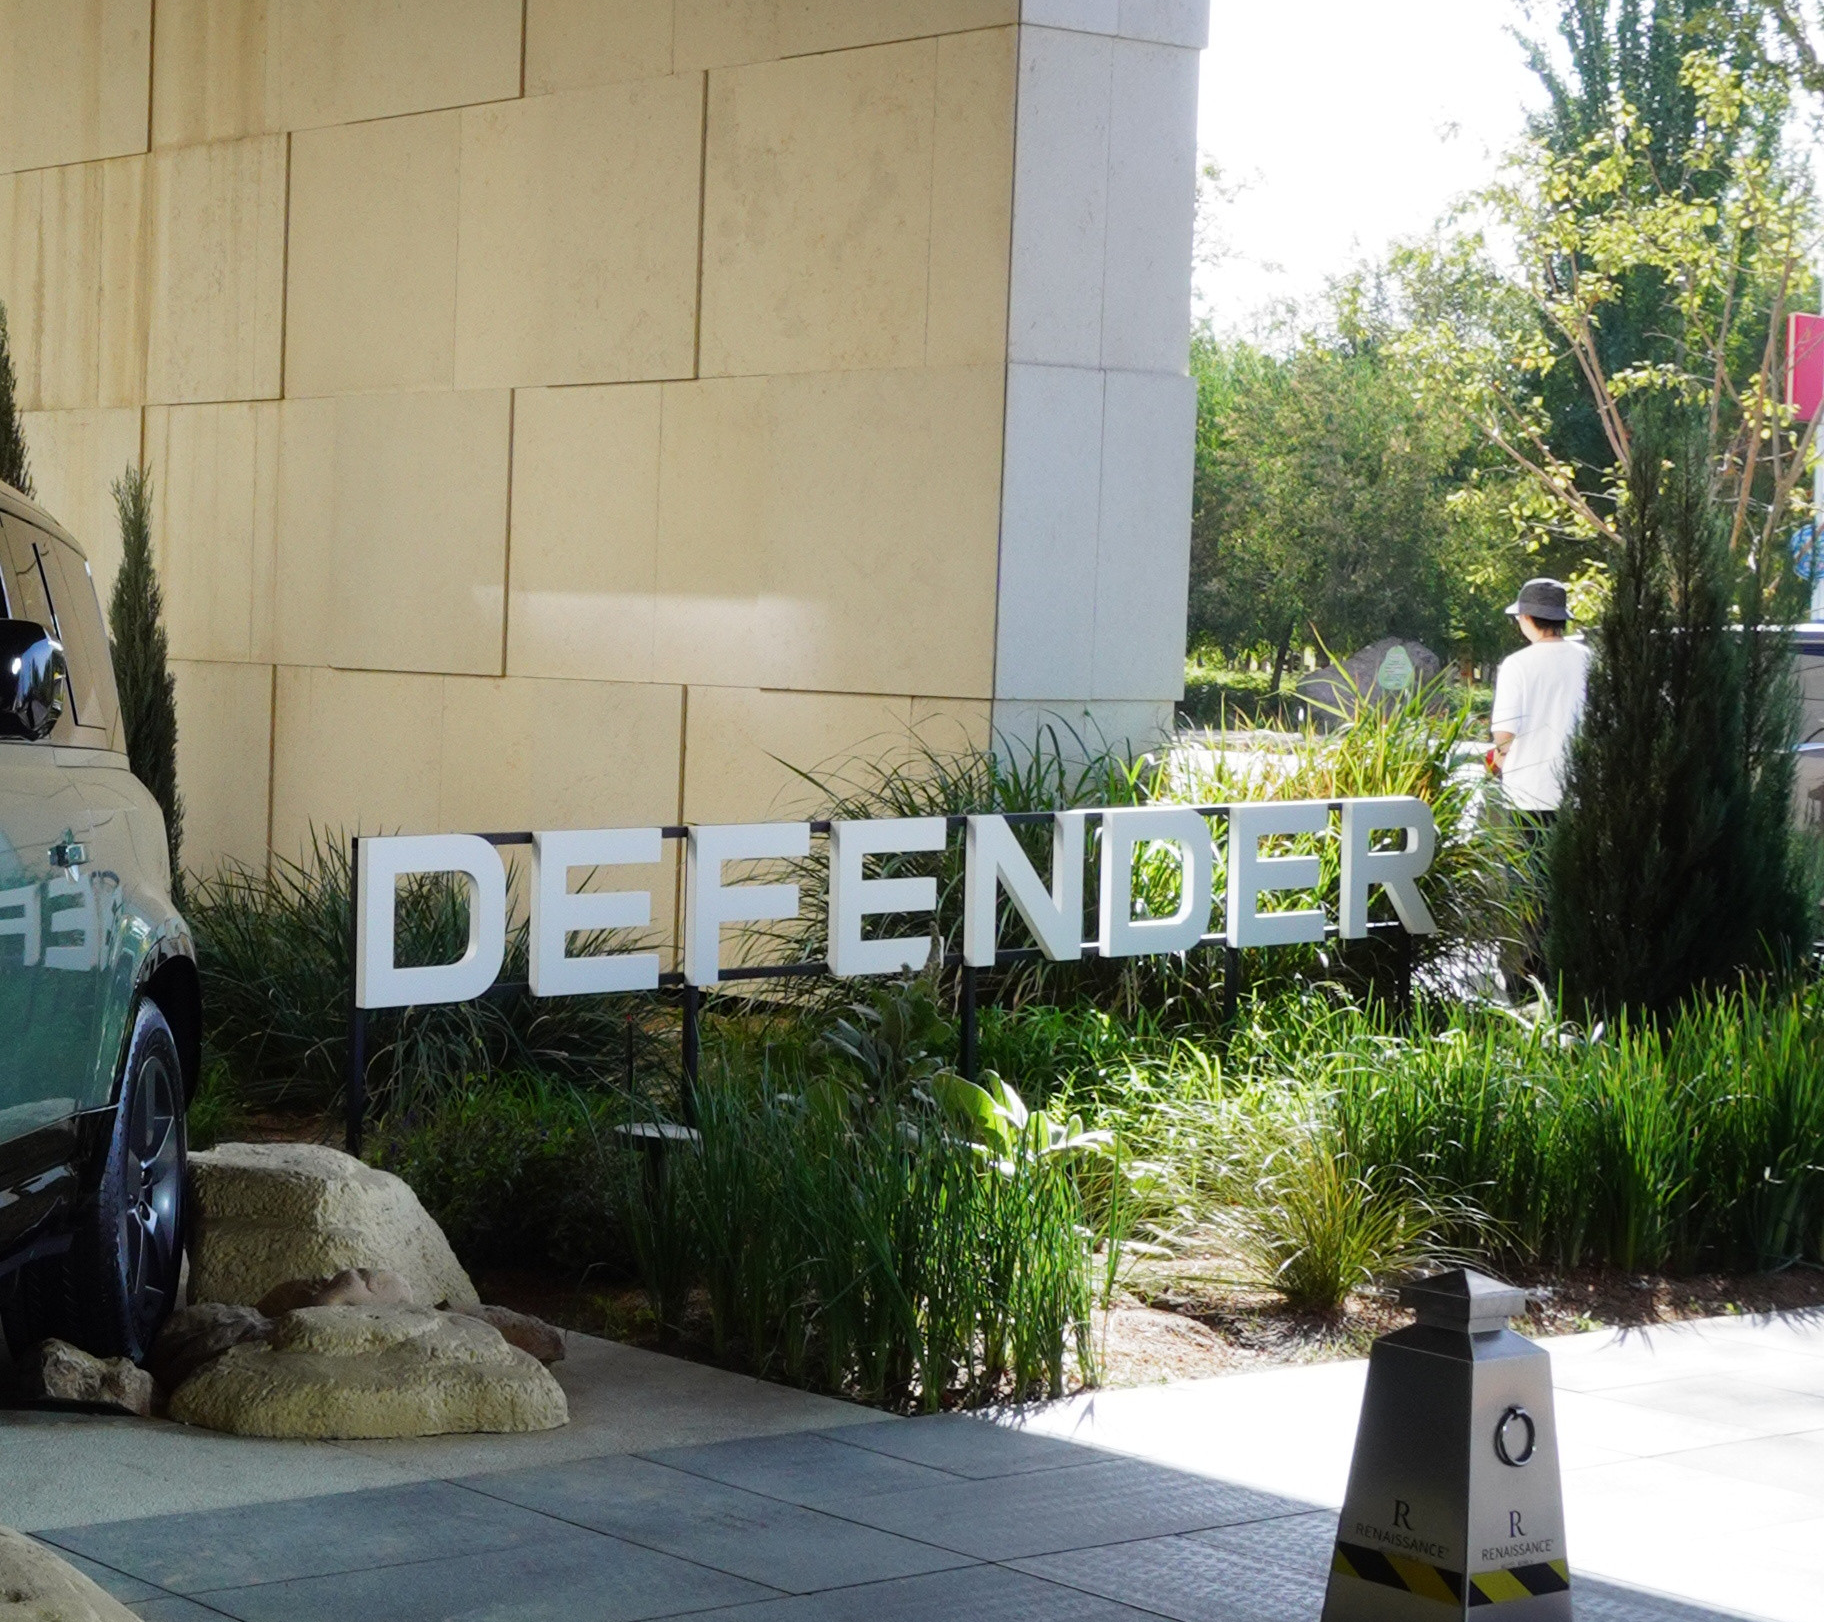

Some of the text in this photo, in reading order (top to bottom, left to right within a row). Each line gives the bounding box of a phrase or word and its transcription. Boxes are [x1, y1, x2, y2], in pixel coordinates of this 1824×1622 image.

[356, 795, 1437, 1009] DEFENDER
[1393, 1499, 1416, 1531] R
[1508, 1510, 1526, 1539] R
